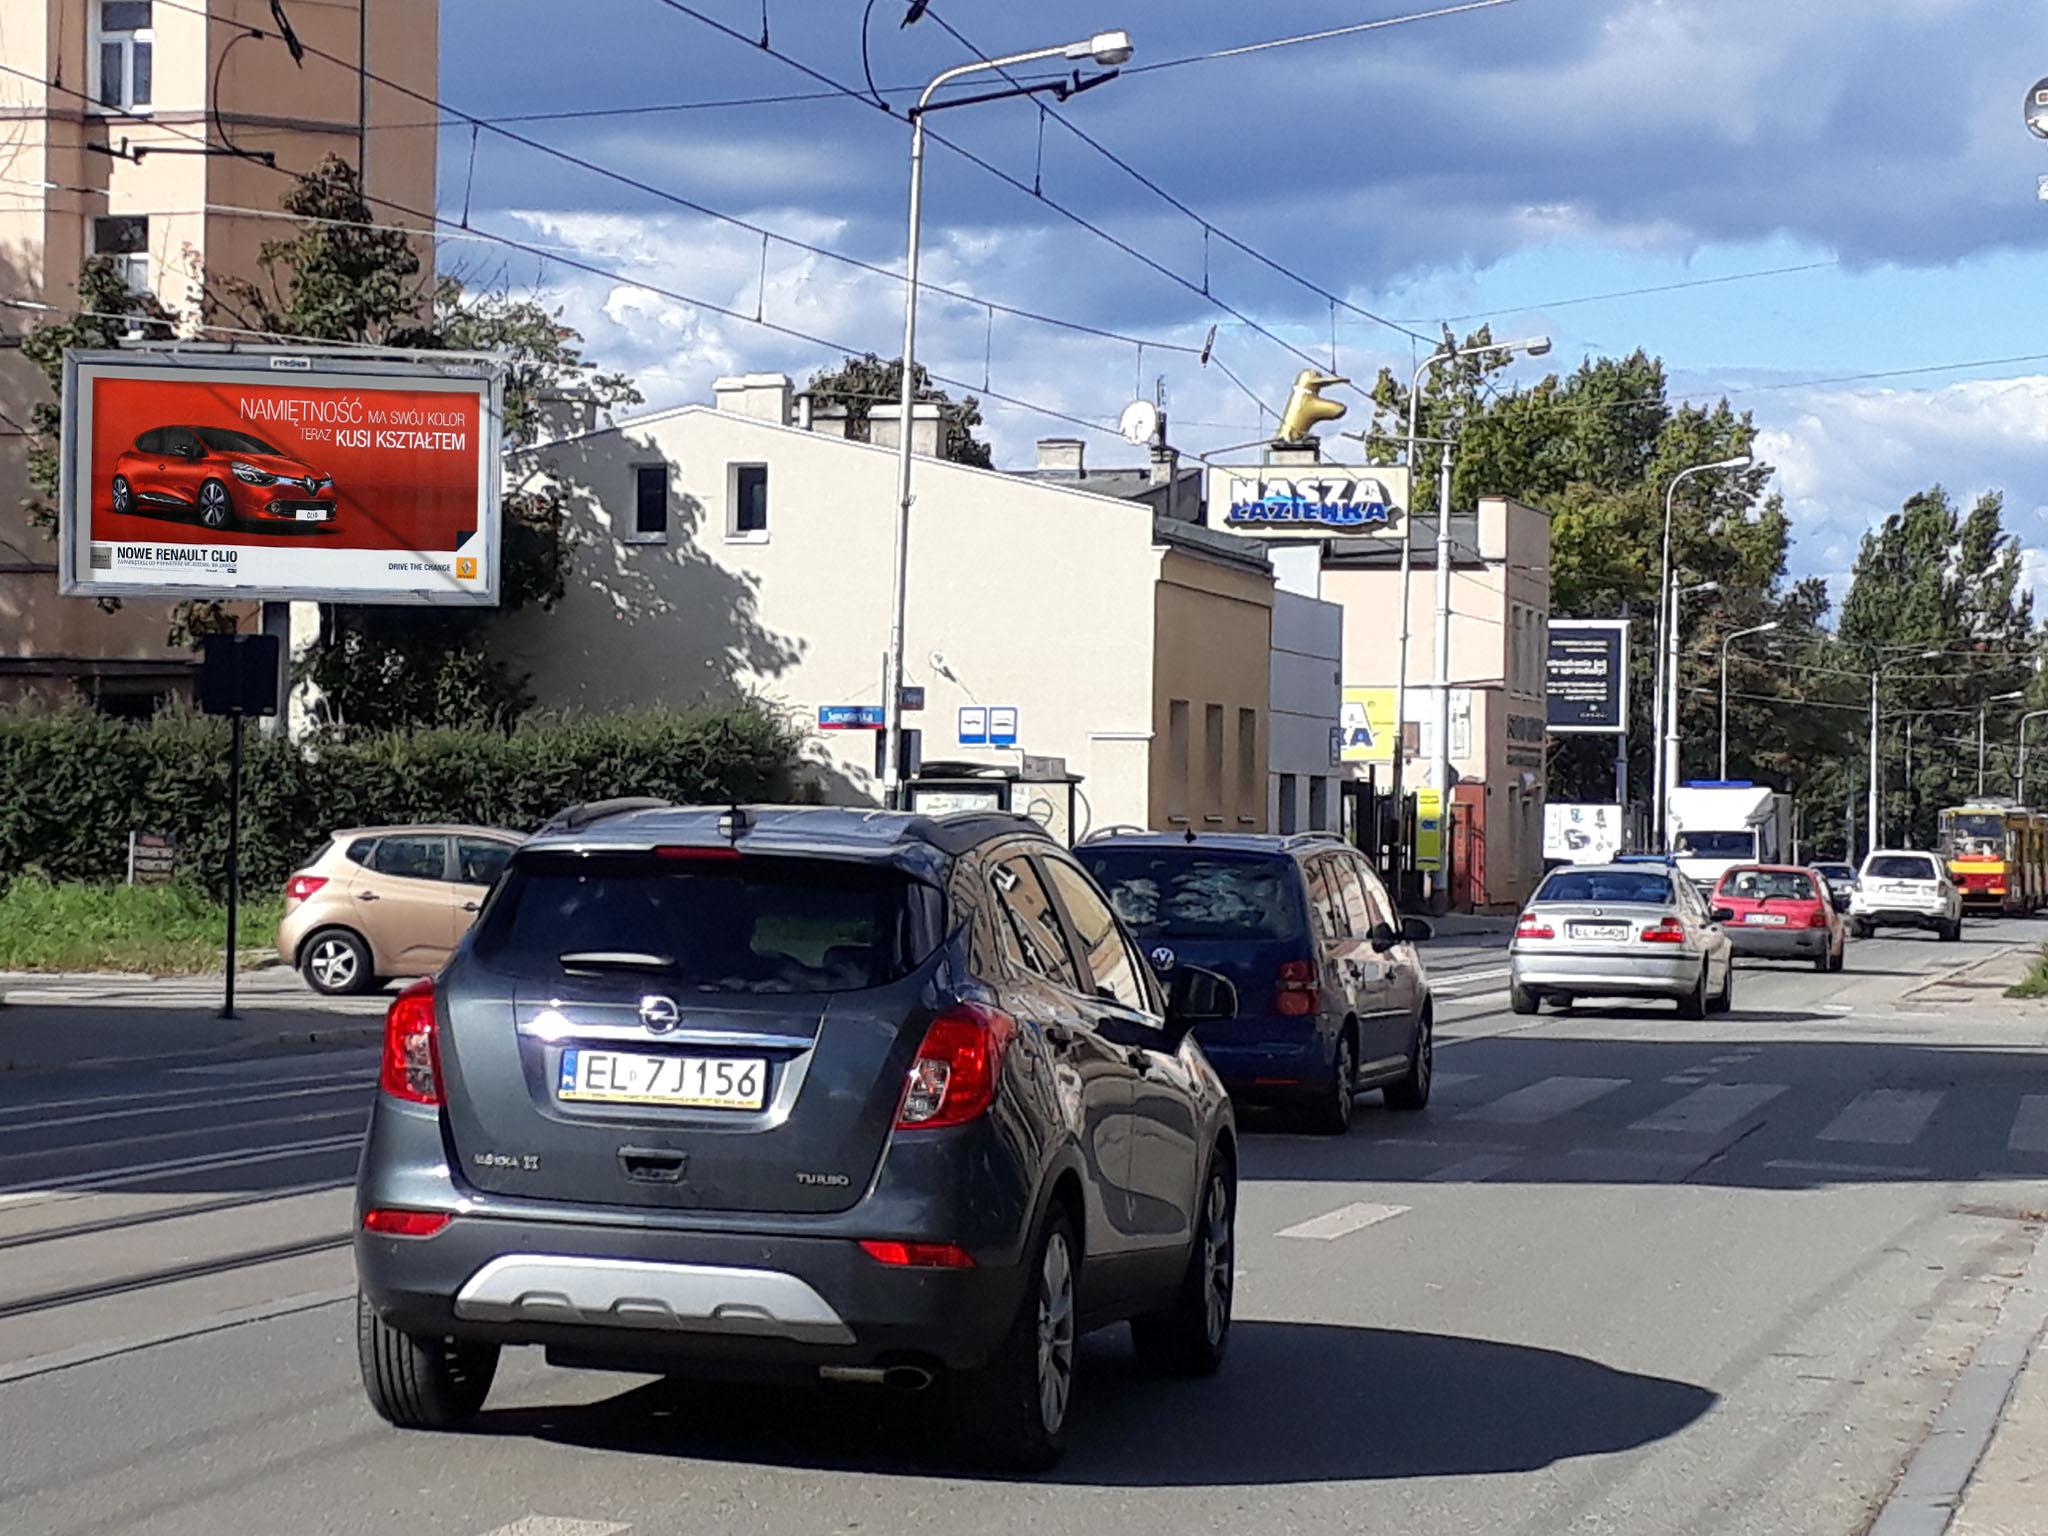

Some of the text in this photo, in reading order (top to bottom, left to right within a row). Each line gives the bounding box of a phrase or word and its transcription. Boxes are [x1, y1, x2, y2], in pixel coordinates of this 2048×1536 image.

[239, 396, 465, 427] NAMIĘTNOŚĆ MA SWÓJ KOLOR
[300, 428, 465, 450] TERAZ KUSI KSZTAŁTEM
[1230, 478, 1387, 502] NASZA
[117, 547, 238, 563] NOWE RENAULT CLIO
[388, 563, 451, 572] DRIVE THE CHANGE
[586, 1055, 757, 1097] EL 7J156
[795, 1172, 850, 1186] TURBO
